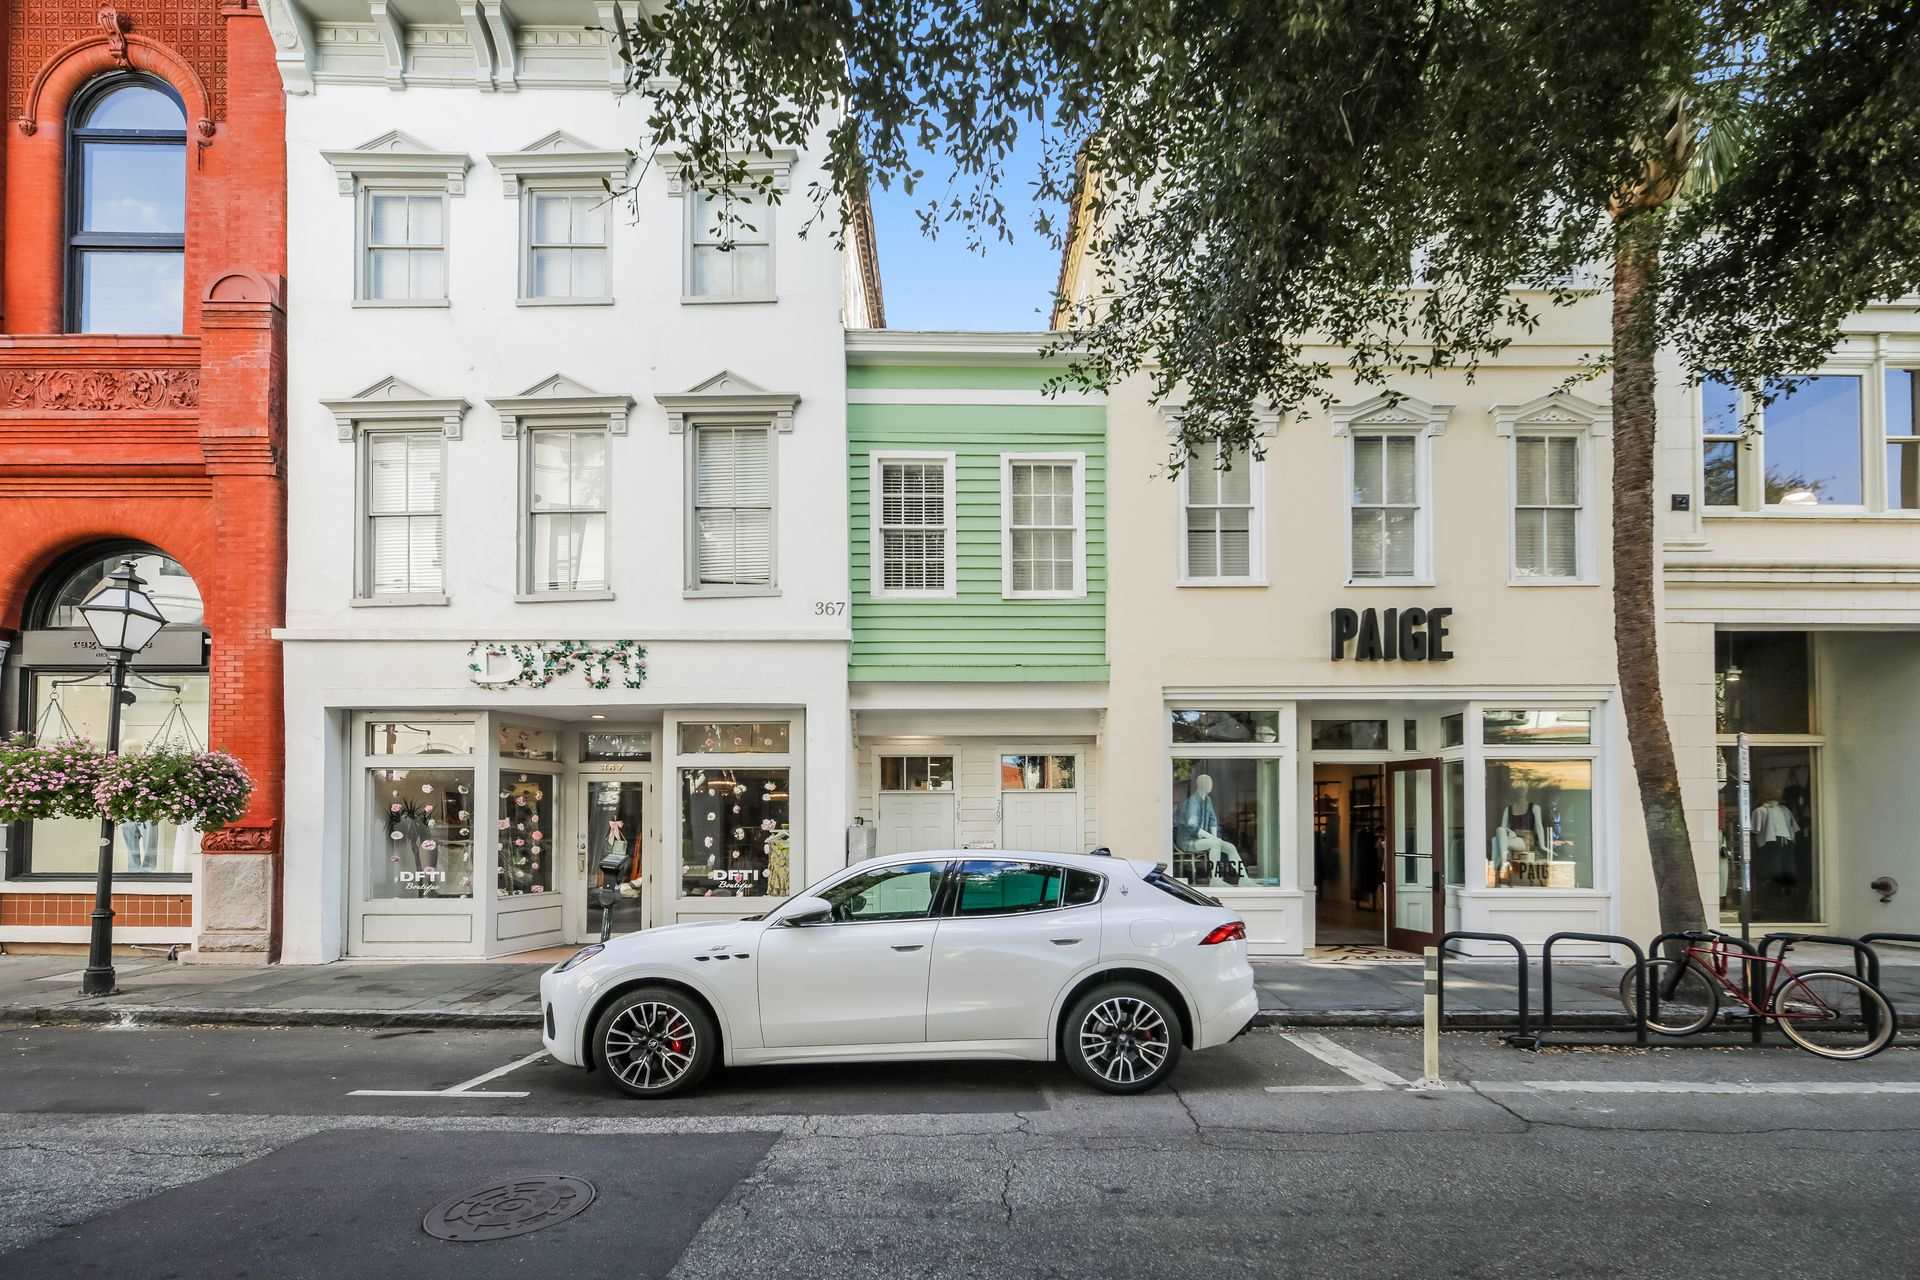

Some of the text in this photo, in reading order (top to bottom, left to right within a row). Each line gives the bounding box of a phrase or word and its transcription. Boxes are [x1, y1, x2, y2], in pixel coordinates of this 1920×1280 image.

[815, 601, 845, 616] 367
[1330, 607, 1454, 662] PAIGE
[400, 871, 446, 882] DFTI
[713, 869, 759, 881] DFTI
[406, 881, 440, 896] Boutique
[718, 880, 753, 894] Boutique
